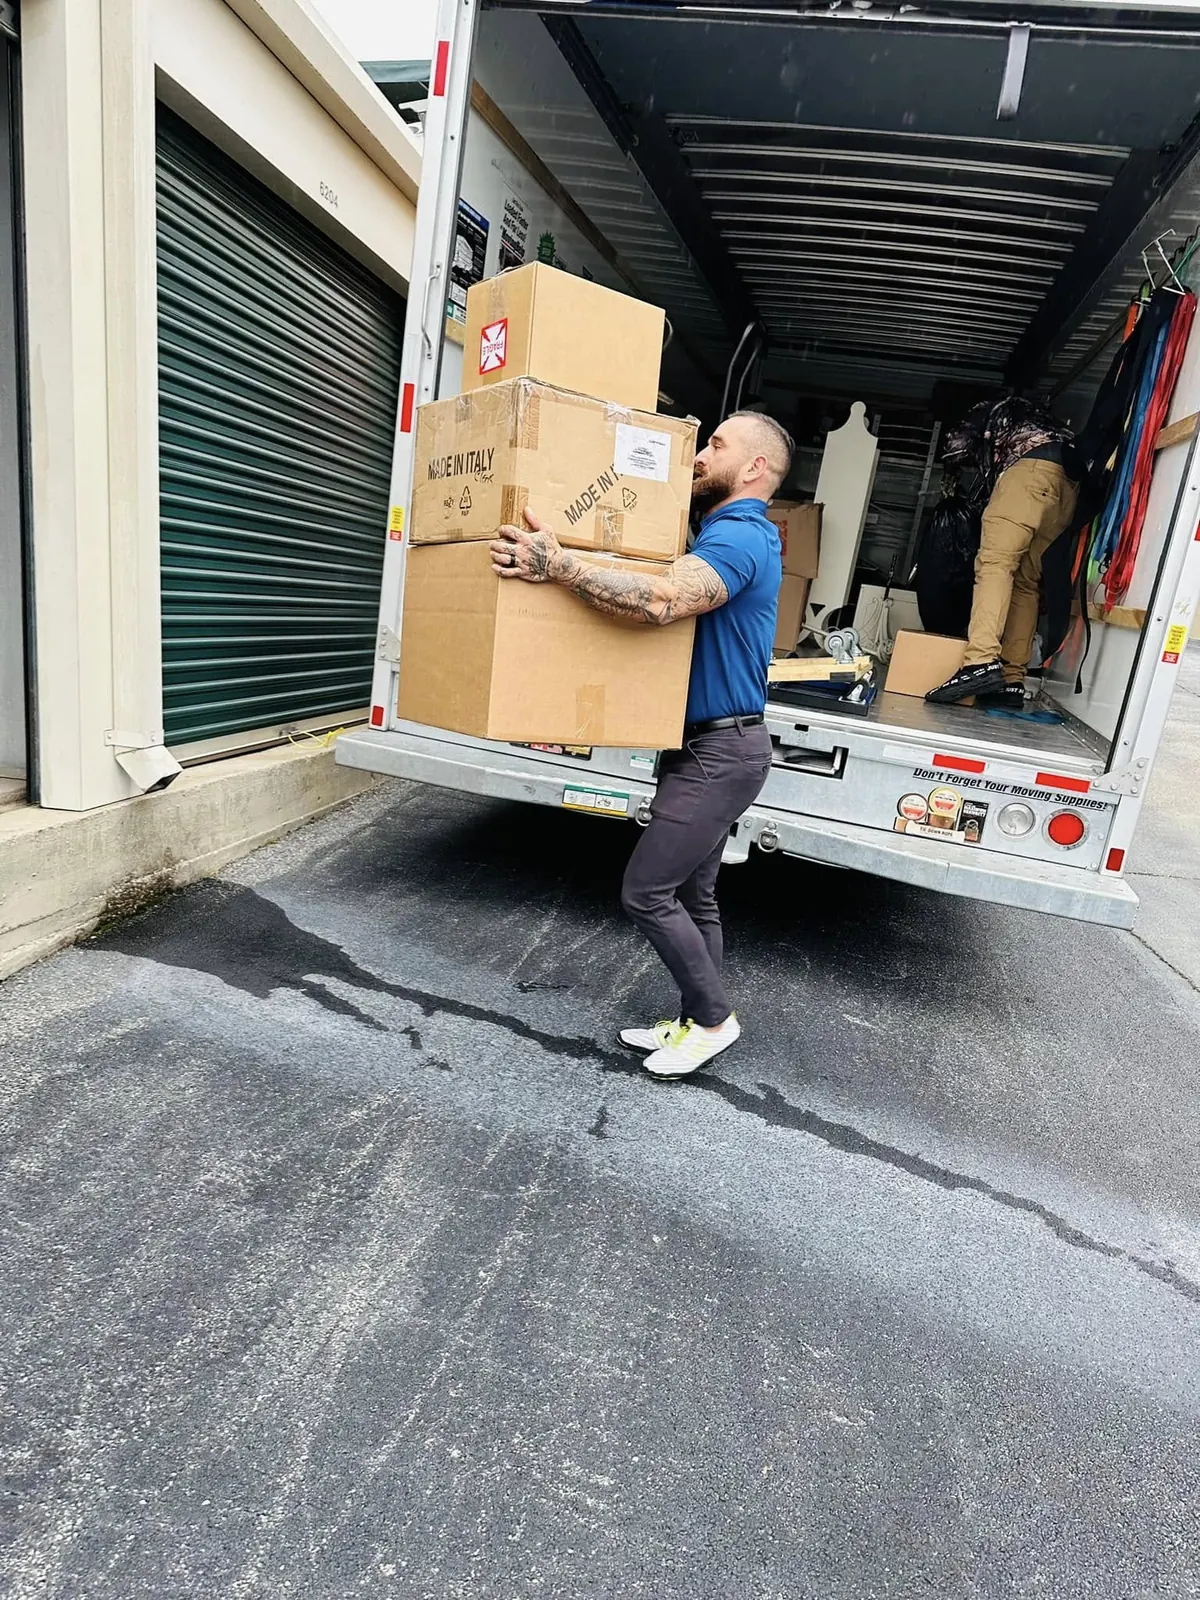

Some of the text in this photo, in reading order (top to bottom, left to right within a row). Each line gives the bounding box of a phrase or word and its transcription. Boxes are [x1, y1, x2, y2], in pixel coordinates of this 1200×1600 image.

[320, 181, 338, 208] 6204
[482, 340, 504, 356] FRAGILE
[427, 447, 495, 481] MADE IN ITALY
[564, 483, 602, 526] MADE
[596, 471, 614, 494] IN
[912, 767, 1109, 810] Don't Forget Your Moving Supplies!
